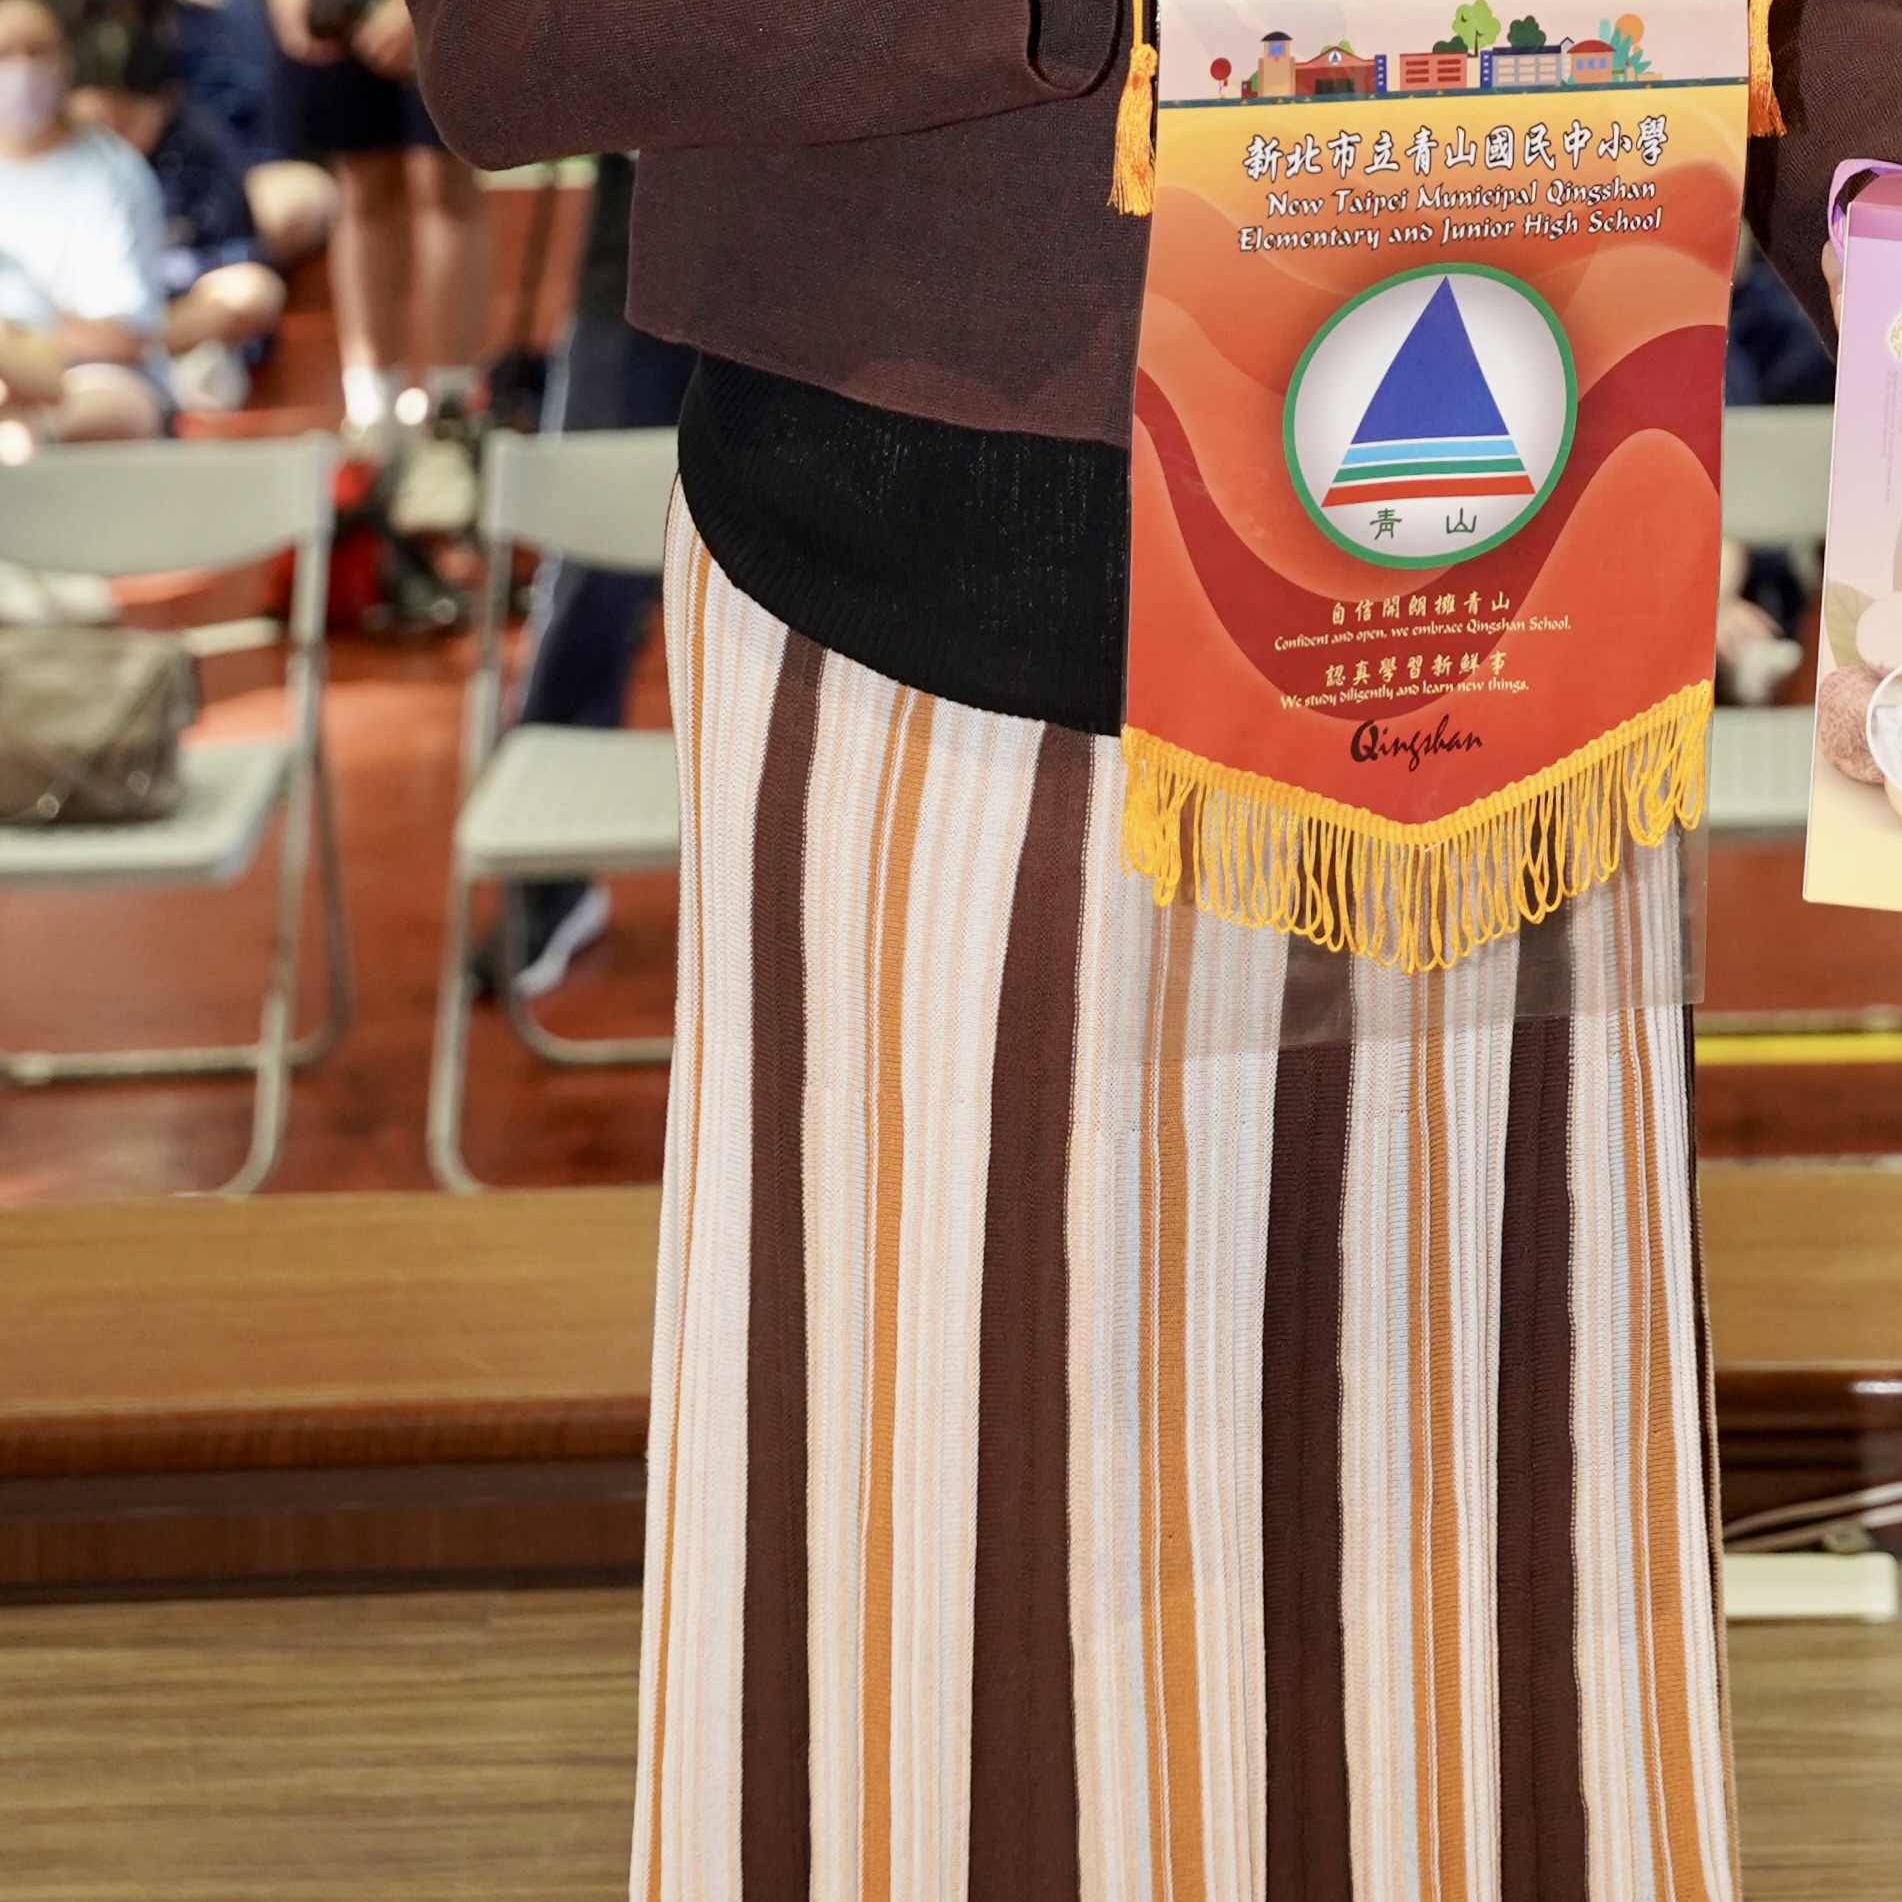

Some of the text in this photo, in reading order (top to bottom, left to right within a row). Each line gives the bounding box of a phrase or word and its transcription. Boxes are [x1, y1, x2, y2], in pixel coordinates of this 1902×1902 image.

[1243, 114, 1669, 183] 新北市立青山國民中小學
[1267, 174, 1657, 219] New Taipei Municipal Qingshan
[1239, 205, 1663, 253] Elementary and Junior High School
[1332, 590, 1511, 626] 自信開朗擁青山
[1274, 633, 1330, 652] Confident
[1331, 630, 1354, 645] and
[1391, 626, 1410, 638] we
[1412, 620, 1464, 637] embrace
[1466, 618, 1526, 636] Qingshan
[1529, 615, 1572, 632] School.
[1325, 650, 1508, 688] 認真學習新鮮事
[1280, 676, 1530, 710] We study diligently and learn new things.
[1350, 713, 1483, 773] Qingshan
